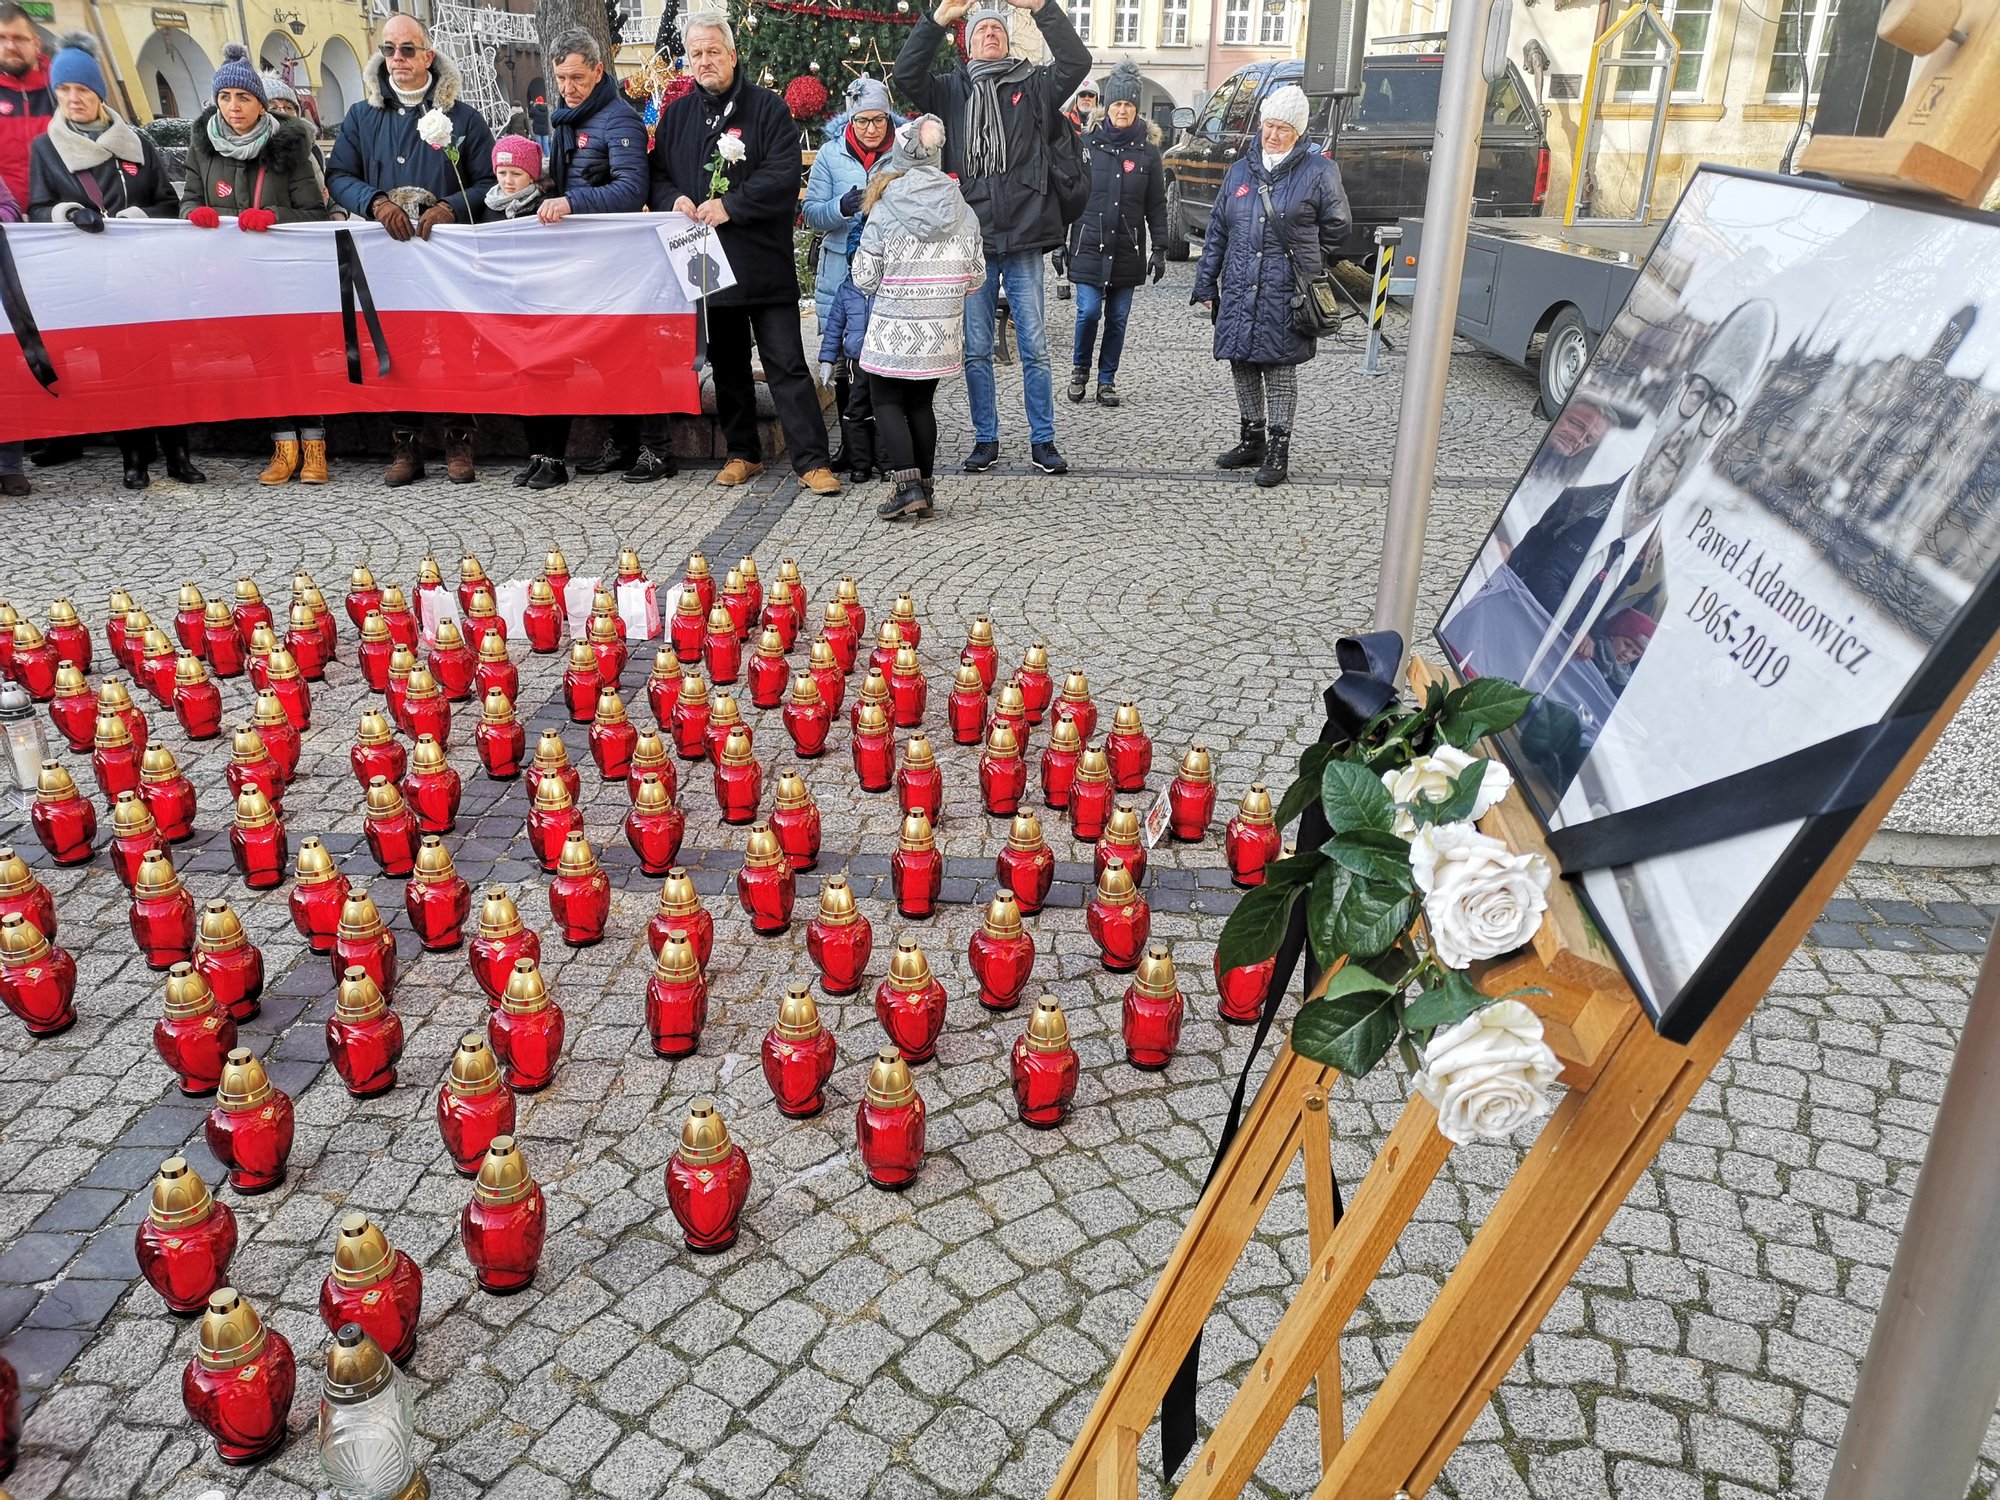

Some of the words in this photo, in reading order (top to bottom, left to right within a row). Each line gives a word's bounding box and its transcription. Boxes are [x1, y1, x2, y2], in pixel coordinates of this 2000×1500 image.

[669, 225, 711, 251] ADAMOWICZ
[1684, 585, 1790, 688] 1965-2019
[1686, 506, 1751, 575] Paweł
[1737, 550, 1872, 676] Adamowicz
